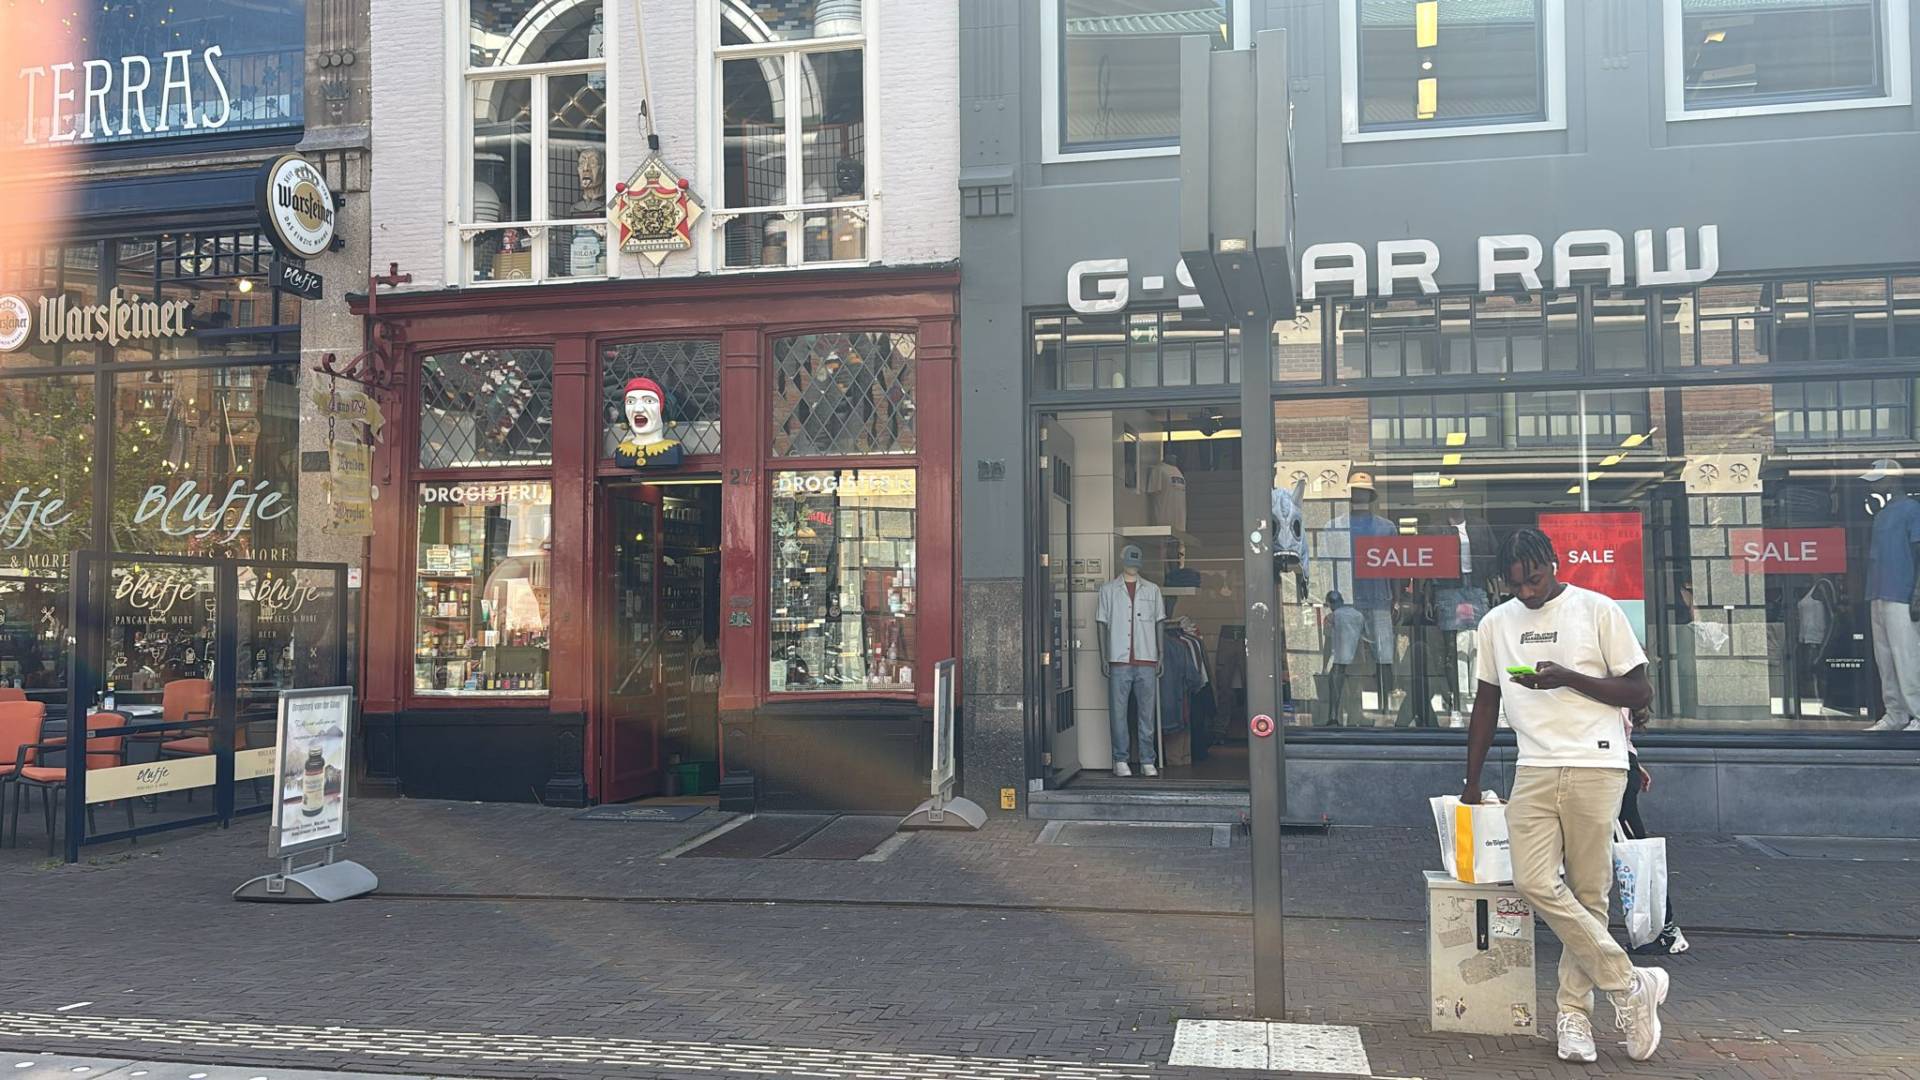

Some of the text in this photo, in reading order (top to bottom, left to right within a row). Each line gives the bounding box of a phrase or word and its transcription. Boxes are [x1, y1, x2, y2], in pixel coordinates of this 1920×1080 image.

[19, 45, 232, 145] TERRAS
[277, 183, 333, 227] Warsteiner
[283, 266, 320, 293] Blufje
[1066, 224, 1719, 314] G-AR RAW
[38, 286, 189, 347] Warsteiner
[729, 468, 753, 485] 27
[425, 484, 548, 503] DROGISTERIJ
[0, 486, 73, 550] fje
[133, 479, 293, 545] Blufje
[28, 554, 70, 569] MORE
[246, 547, 289, 561] MORE
[1366, 547, 1434, 568] SALE
[1568, 549, 1615, 564] SALE
[1743, 540, 1818, 563] SALE
[114, 573, 198, 614] Blufje
[256, 577, 320, 614] Blufje
[171, 615, 193, 625] MORE
[136, 766, 170, 784] Blufje
